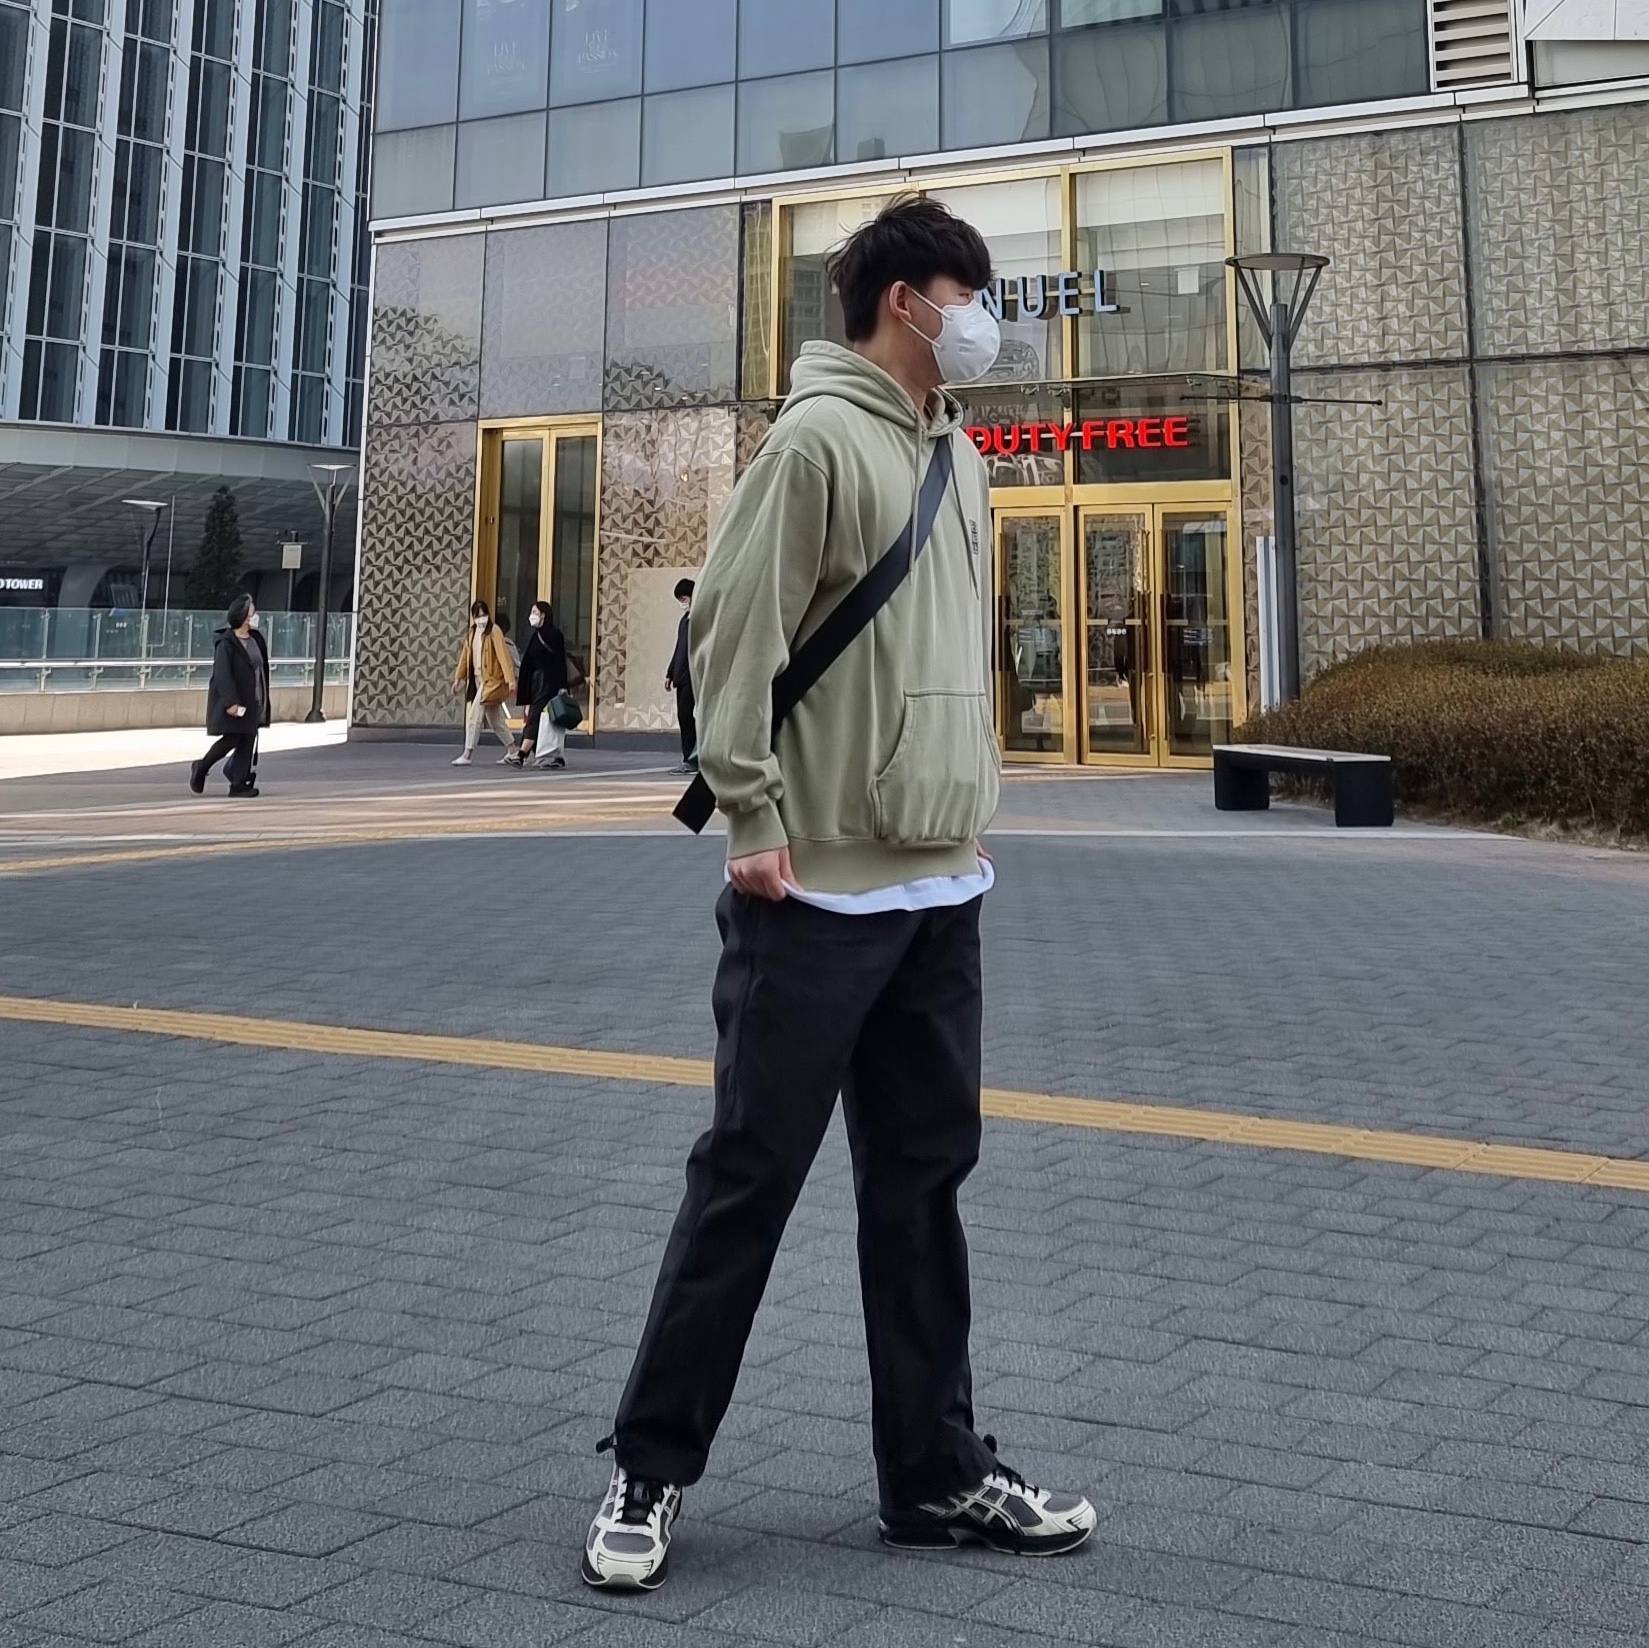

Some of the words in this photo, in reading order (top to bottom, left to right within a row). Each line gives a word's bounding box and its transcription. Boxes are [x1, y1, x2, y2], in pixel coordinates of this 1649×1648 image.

[966, 423, 1076, 455] DUTY
[1081, 416, 1189, 450] FREE
[5, 578, 44, 590] TOWER
